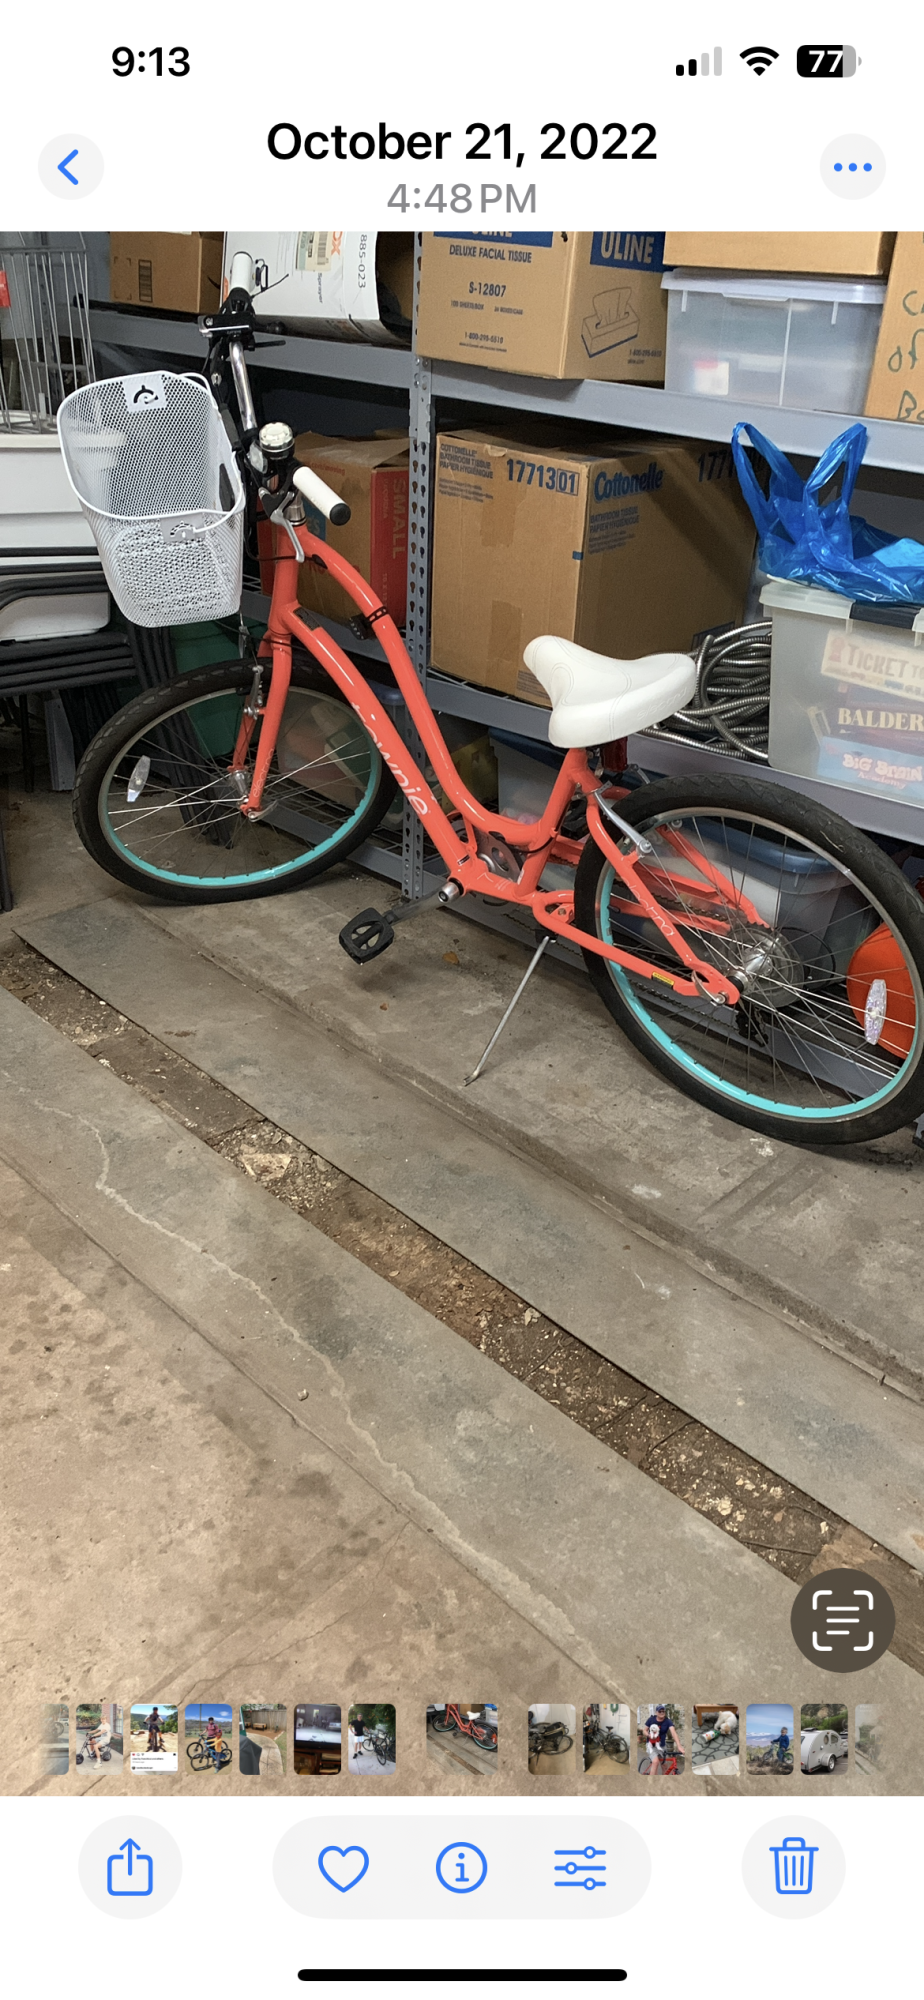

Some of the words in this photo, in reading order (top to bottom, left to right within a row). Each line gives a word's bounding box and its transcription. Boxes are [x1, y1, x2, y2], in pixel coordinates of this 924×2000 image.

[358, 234, 368, 288] 885-023
[449, 244, 477, 257] DELUXE
[478, 247, 506, 261] FACIAL
[508, 250, 532, 263] TISSUE
[601, 231, 655, 264] ULINE
[469, 281, 507, 297] S-12807
[440, 451, 471, 466] BATHROOM
[471, 459, 492, 470] TISSUE
[594, 461, 664, 502] Cottonelle
[393, 478, 406, 559] SMALL
[847, 643, 909, 679] TICKET
[838, 707, 924, 732] BALDER
[857, 771, 908, 790] Academy
